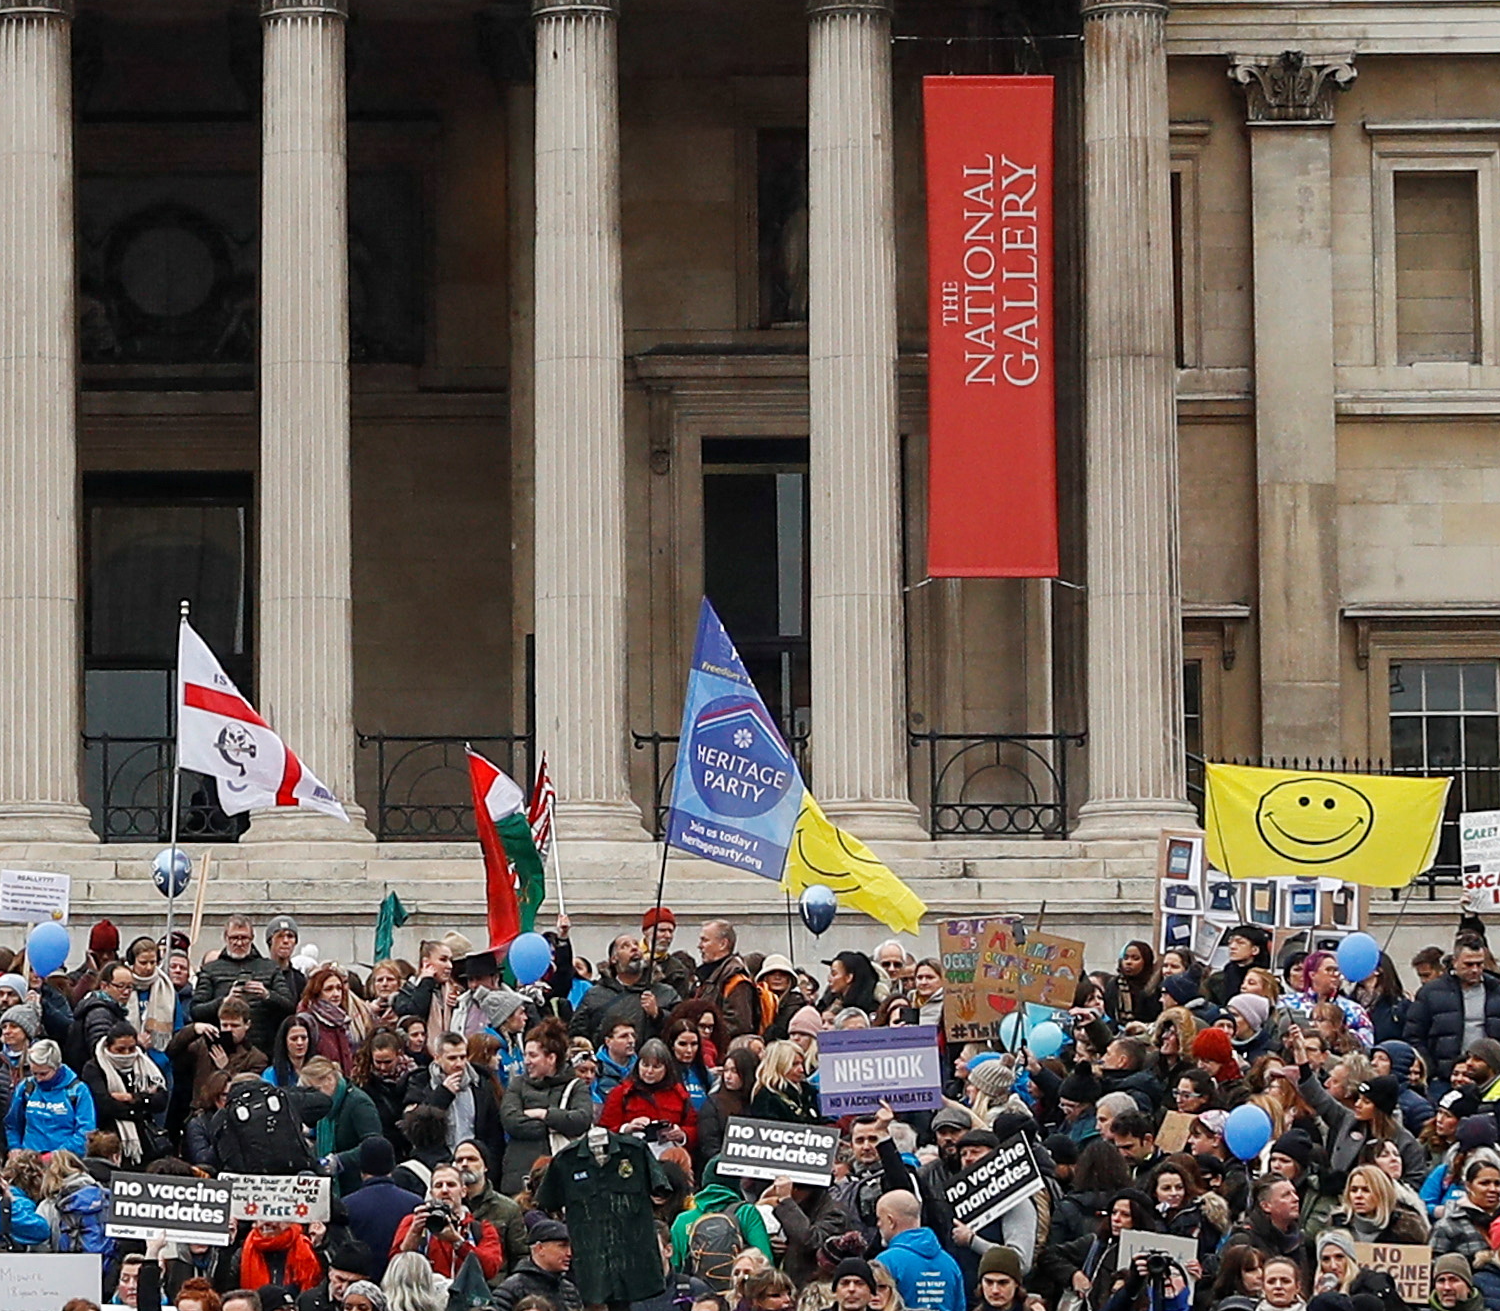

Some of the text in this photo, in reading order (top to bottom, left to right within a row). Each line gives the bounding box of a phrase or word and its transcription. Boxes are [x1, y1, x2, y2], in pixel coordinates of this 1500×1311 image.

[963, 152, 995, 386] NATIONAL
[1001, 155, 1040, 387] GALLERY
[942, 281, 958, 326] THE
[697, 743, 787, 790] HERITAGE
[704, 770, 765, 803] PARTY
[682, 832, 762, 870] heritageparty.org
[706, 828, 717, 838] us
[719, 829, 752, 852] today
[834, 1054, 924, 1083] NHS100K
[830, 1091, 934, 1107] NO VACCINE MANDATES
[727, 1123, 835, 1148] no vaccine
[726, 1142, 828, 1167] mandates
[946, 1142, 1026, 1203] no vaccine
[113, 1181, 229, 1204] no vaccine
[954, 1160, 1031, 1219] mandates
[115, 1200, 225, 1224] mandates
[1373, 1247, 1402, 1262] NO
